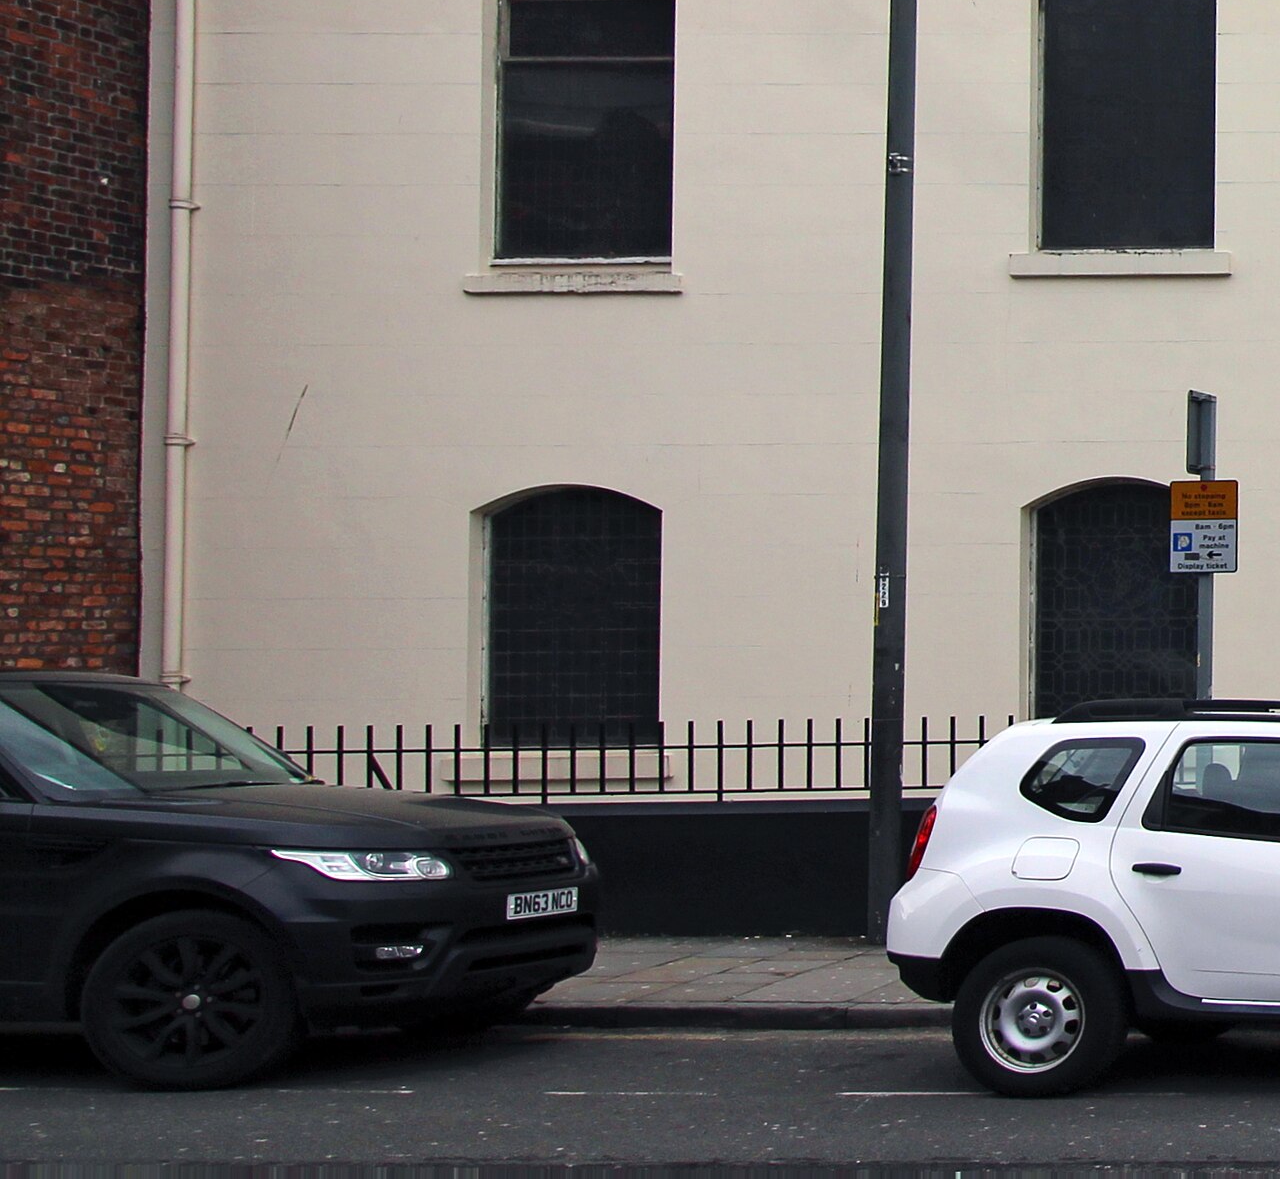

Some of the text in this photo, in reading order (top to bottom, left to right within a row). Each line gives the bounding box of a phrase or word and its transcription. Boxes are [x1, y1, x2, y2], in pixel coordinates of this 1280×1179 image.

[1218, 522, 1234, 531] 6pm
[1203, 534, 1216, 542] Pay
[1206, 562, 1227, 570] ticket
[514, 893, 549, 915] BN63
